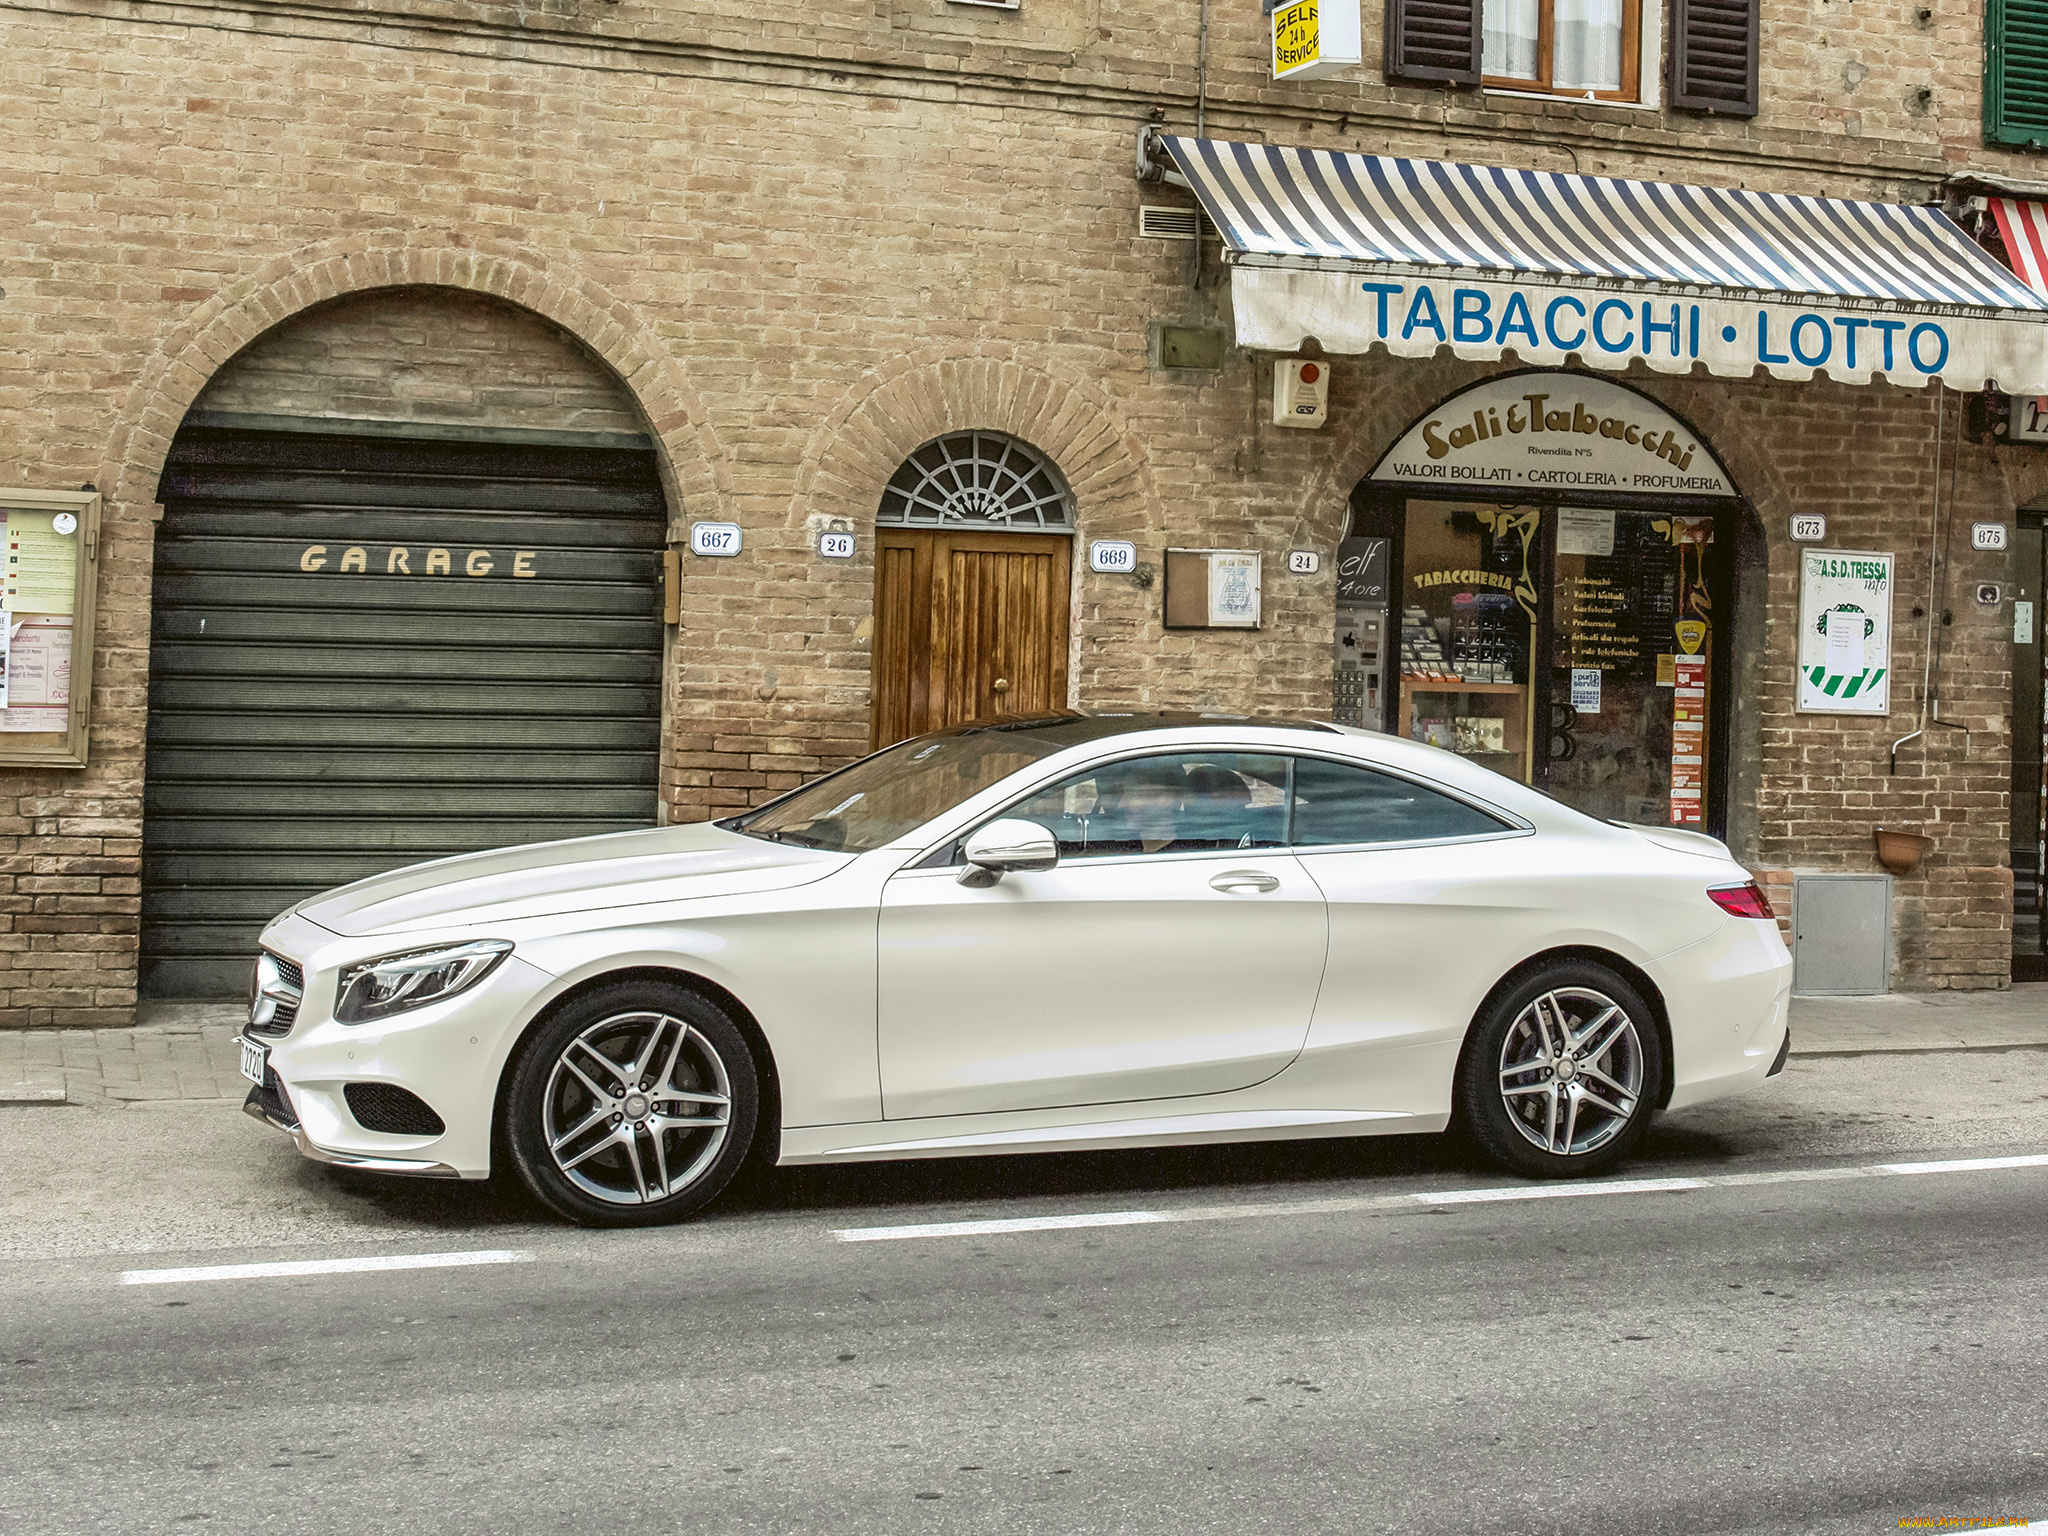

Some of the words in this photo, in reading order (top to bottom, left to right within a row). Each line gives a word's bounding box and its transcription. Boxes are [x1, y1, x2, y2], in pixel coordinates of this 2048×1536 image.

[1277, 7, 1318, 39] SELF
[1277, 30, 1319, 63] SERVICE
[1290, 29, 1298, 45] 24
[1361, 282, 1699, 358] TABACCHI
[1756, 310, 1950, 374] LOTTO
[1422, 406, 1503, 460] Sali
[1523, 394, 1696, 472] Tabacchi
[1528, 446, 1572, 457] Rivendita
[1393, 463, 1446, 478] VALORI
[1451, 466, 1512, 482] BOLLATI
[1528, 470, 1617, 486] CARTOLERIA
[1633, 475, 1723, 491] PROFUMERIA
[1797, 521, 1820, 536] 673
[1978, 530, 2001, 544] 675
[702, 531, 732, 549] 667
[827, 538, 847, 553] 26
[300, 545, 536, 578] GARAGE
[1099, 549, 1127, 565] 669
[1295, 554, 1311, 569] 24
[1414, 569, 1513, 591] TABACCHERIA
[1864, 574, 1887, 595] info
